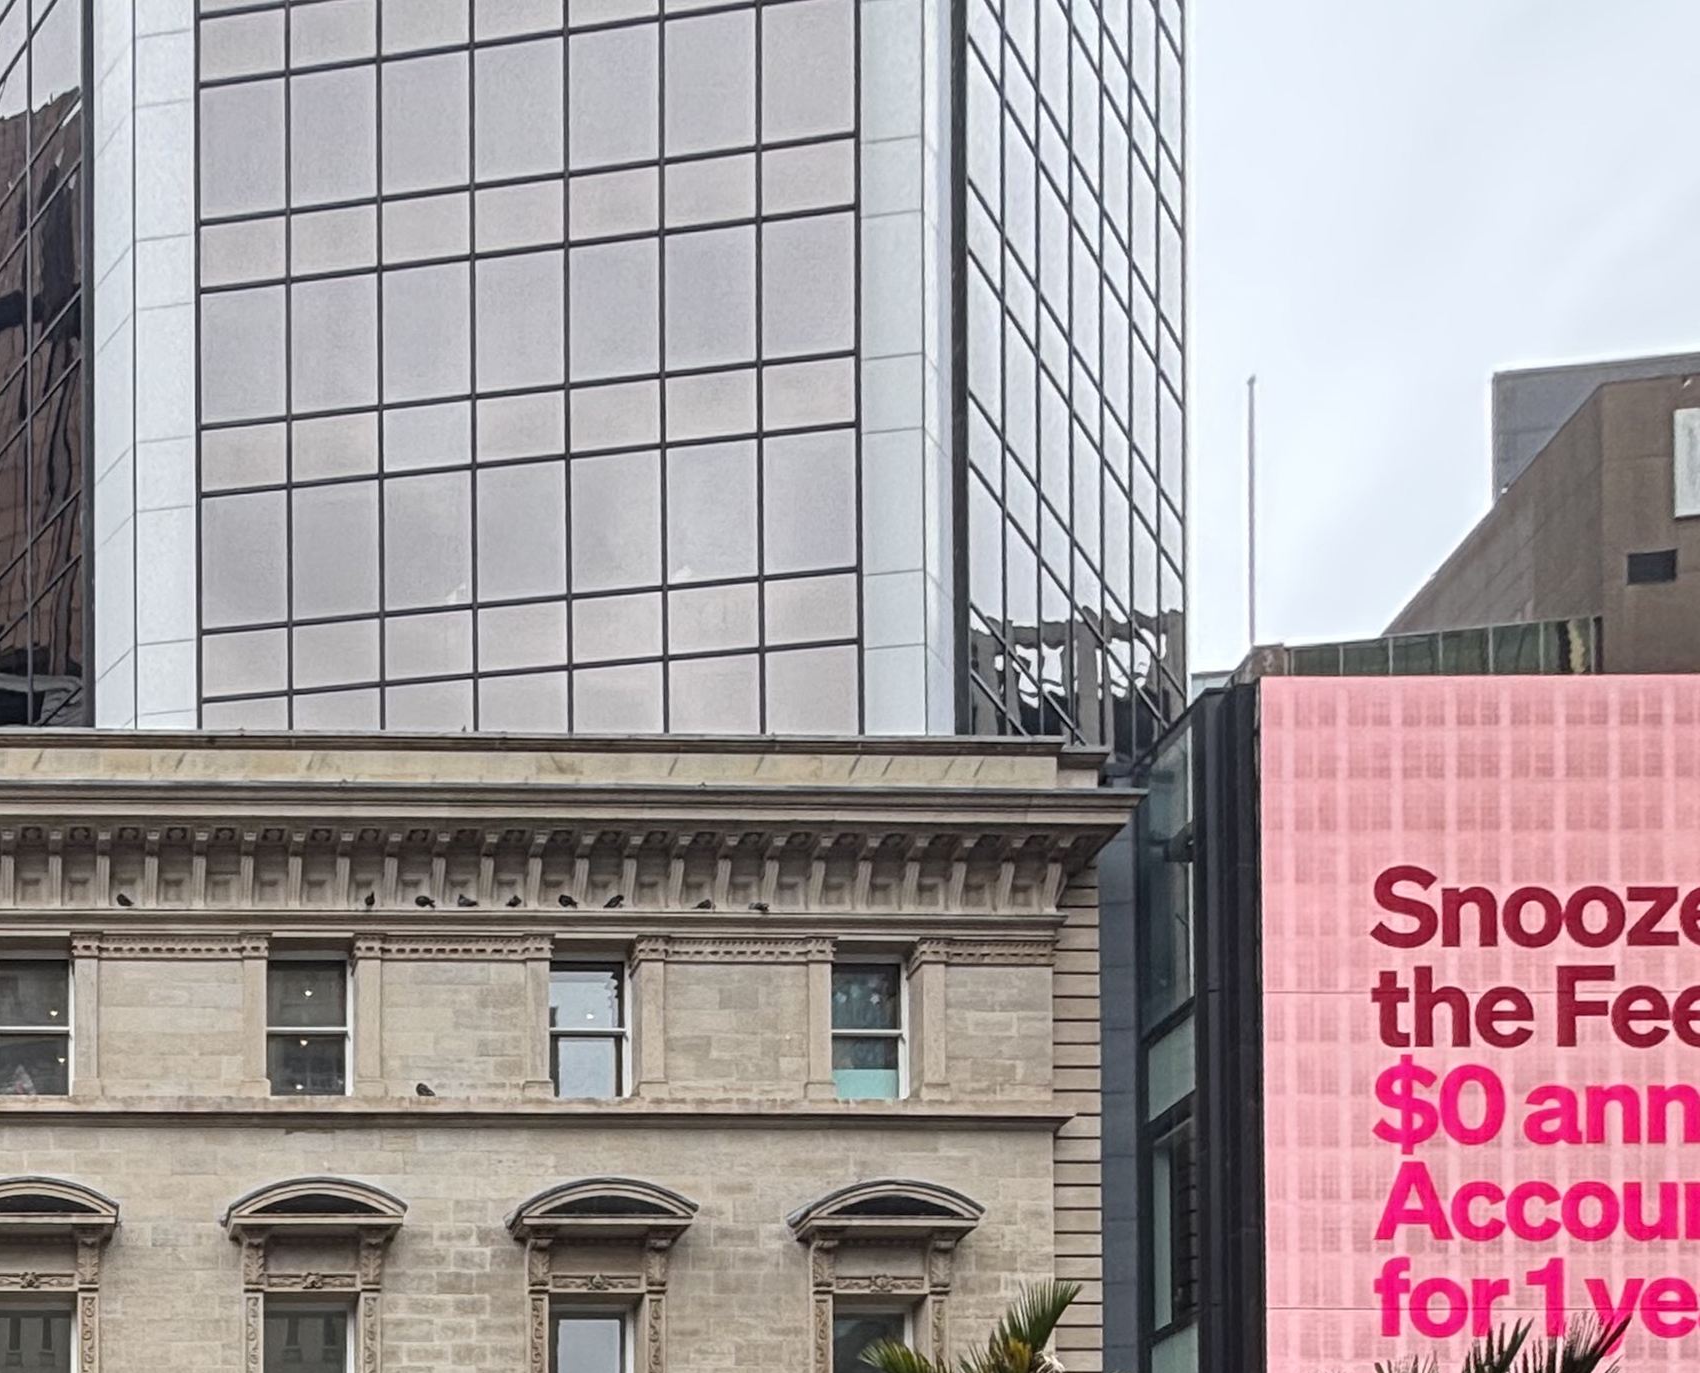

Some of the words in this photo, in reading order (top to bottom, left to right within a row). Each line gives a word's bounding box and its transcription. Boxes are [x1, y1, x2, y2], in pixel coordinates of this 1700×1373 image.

[1371, 965, 1534, 1048] the
[1372, 1054, 1505, 1155] $0
[1374, 1161, 1700, 1241] Accou
[1374, 1257, 1509, 1338] for
[1526, 1258, 1565, 1337] 1
